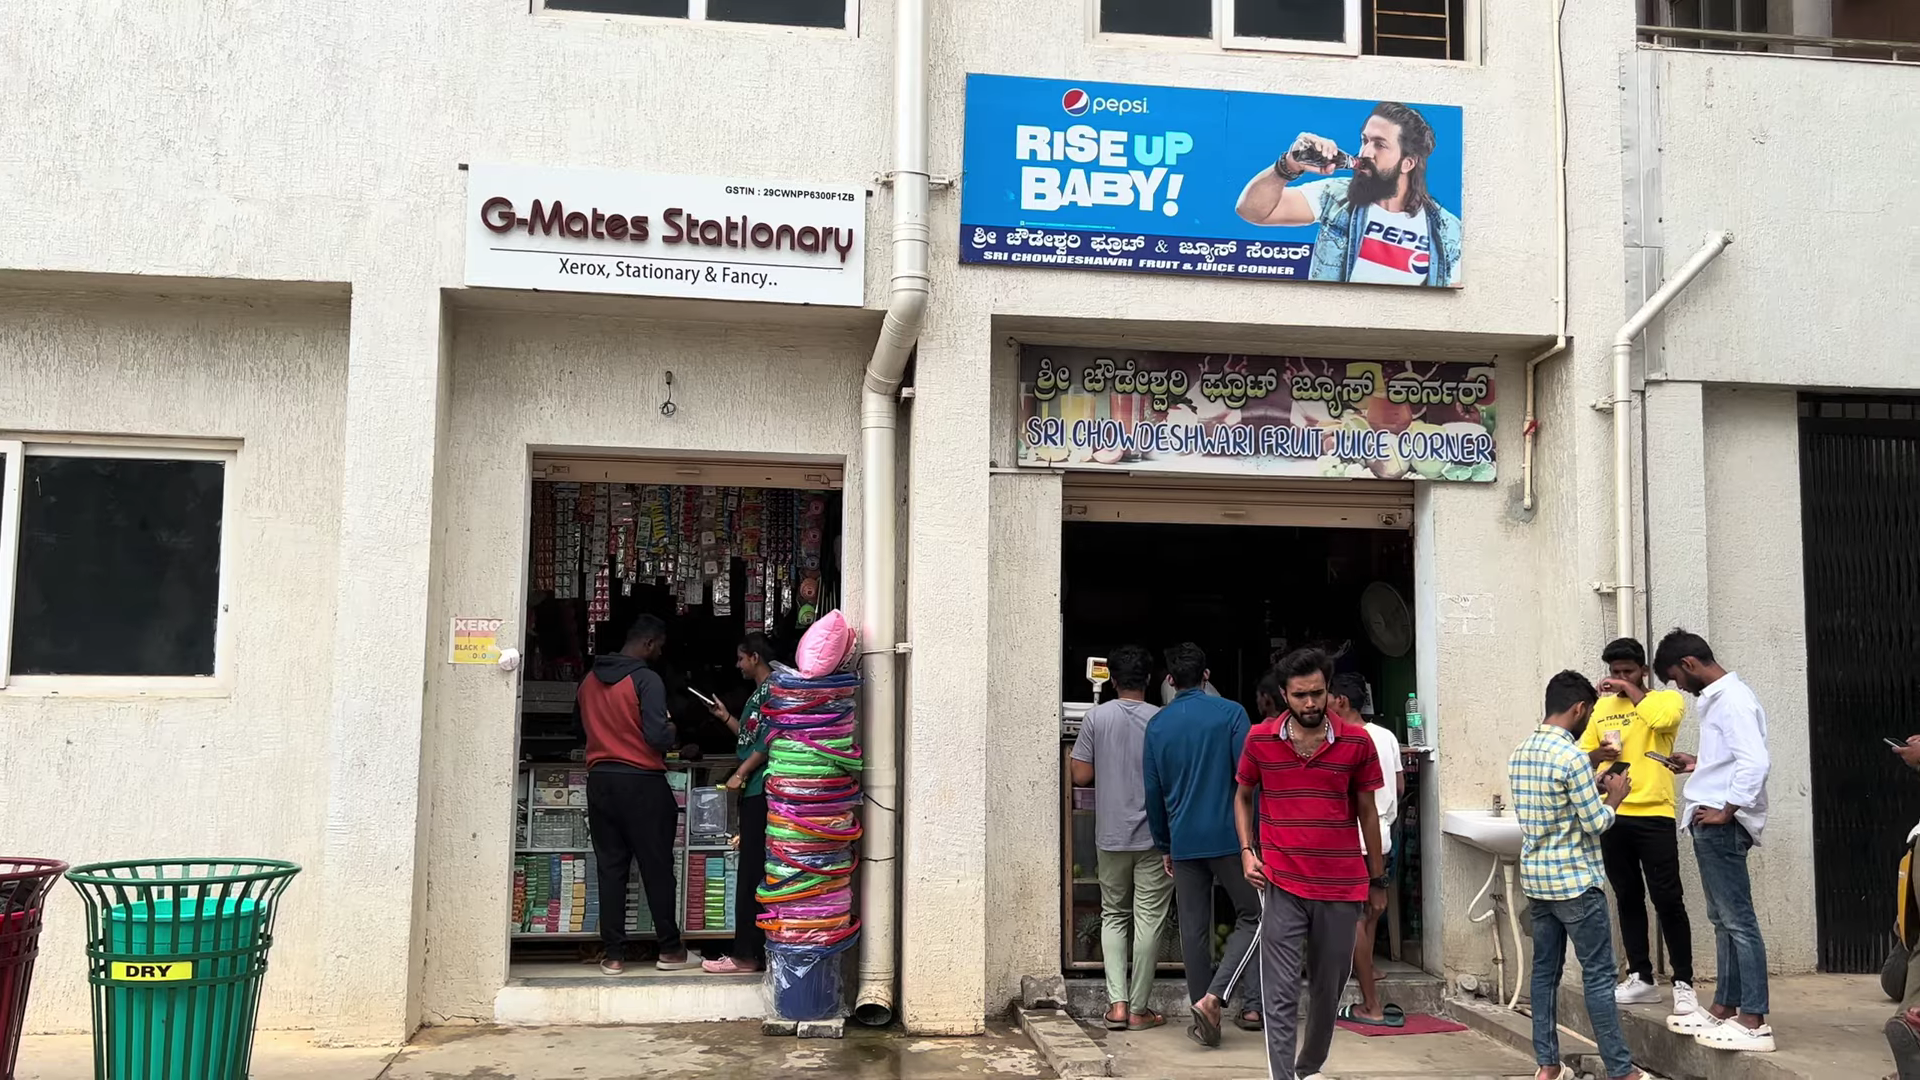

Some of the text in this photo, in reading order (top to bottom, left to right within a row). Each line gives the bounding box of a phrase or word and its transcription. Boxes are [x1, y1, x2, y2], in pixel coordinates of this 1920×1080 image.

[1093, 97, 1148, 116] pepsi
[1134, 131, 1194, 166] UP
[725, 186, 755, 195] GSTIN
[763, 188, 855, 201] 29CWNPP6300F1ZB
[1020, 166, 1184, 217] BABY!
[481, 196, 854, 263] G-Mates Stationary
[971, 227, 997, 248] ಶ್ರೀ
[1006, 227, 1081, 255] ಚೌಡೇಶ್ವರಿ
[1154, 239, 1169, 254] &
[1178, 241, 1237, 263] ಜ್ಯೂಸ್
[1246, 242, 1310, 260] ಸೆಂಟರ್
[558, 257, 778, 289] Xerox, Stationary & Fancy..
[983, 251, 1009, 261] SRI
[1011, 252, 1133, 267] CHOWDESHAWRI
[1138, 259, 1180, 269] FRUIT
[1195, 263, 1236, 273] JUICE
[1237, 265, 1295, 275] CORNER
[1034, 358, 1071, 401] ಶ್ರೀ
[1083, 357, 1189, 411] ಚೌಡೇಶ್ವರಿ
[1291, 369, 1375, 418] ಜ್ಯೂಸ್
[1386, 374, 1489, 405] ಕಾರ್ನರ್
[1027, 417, 1492, 462] SRI CHOWDESHWARI FRUIT JUICE CORNER
[125, 964, 172, 978] DRY
